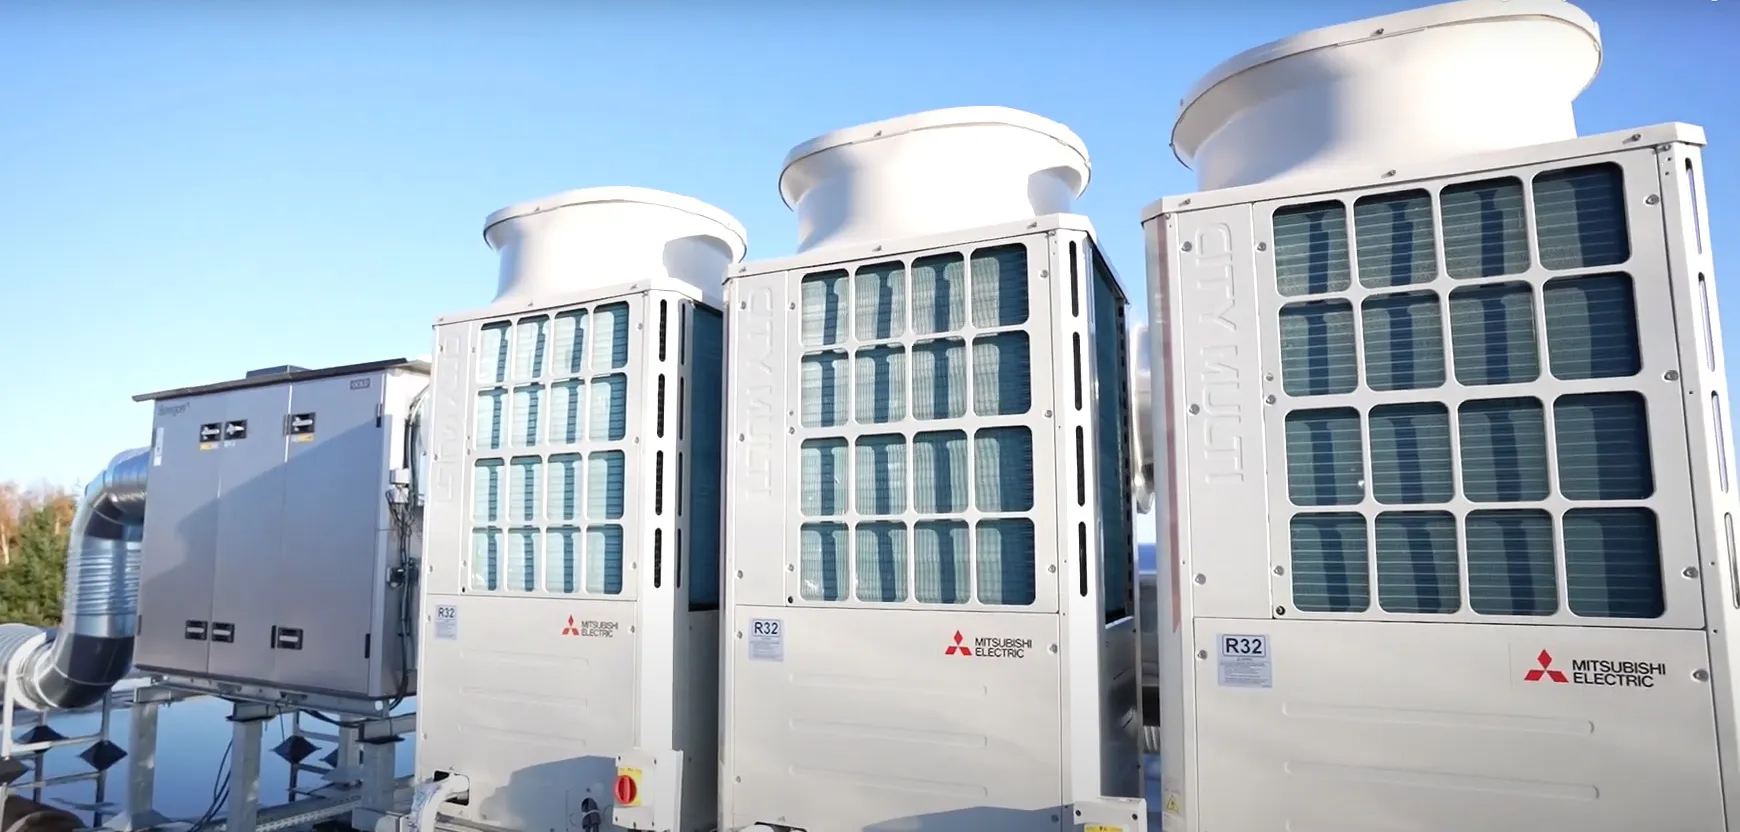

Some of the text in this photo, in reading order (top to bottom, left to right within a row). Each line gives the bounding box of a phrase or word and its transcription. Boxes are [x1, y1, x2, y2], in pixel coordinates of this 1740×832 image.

[747, 286, 773, 375] CITY
[1195, 222, 1244, 484] CITY MULTI
[438, 607, 455, 618] R32
[581, 620, 619, 629] MITSUBISHI
[754, 621, 779, 635] R32
[581, 628, 613, 638] ELECTRIC
[974, 637, 1032, 649] MITSUBISHI
[1225, 637, 1262, 654] R32
[974, 647, 1025, 659] ELECTRIC
[1572, 659, 1667, 675] MITSUBISHI
[1573, 672, 1655, 688] ELECTRIC
